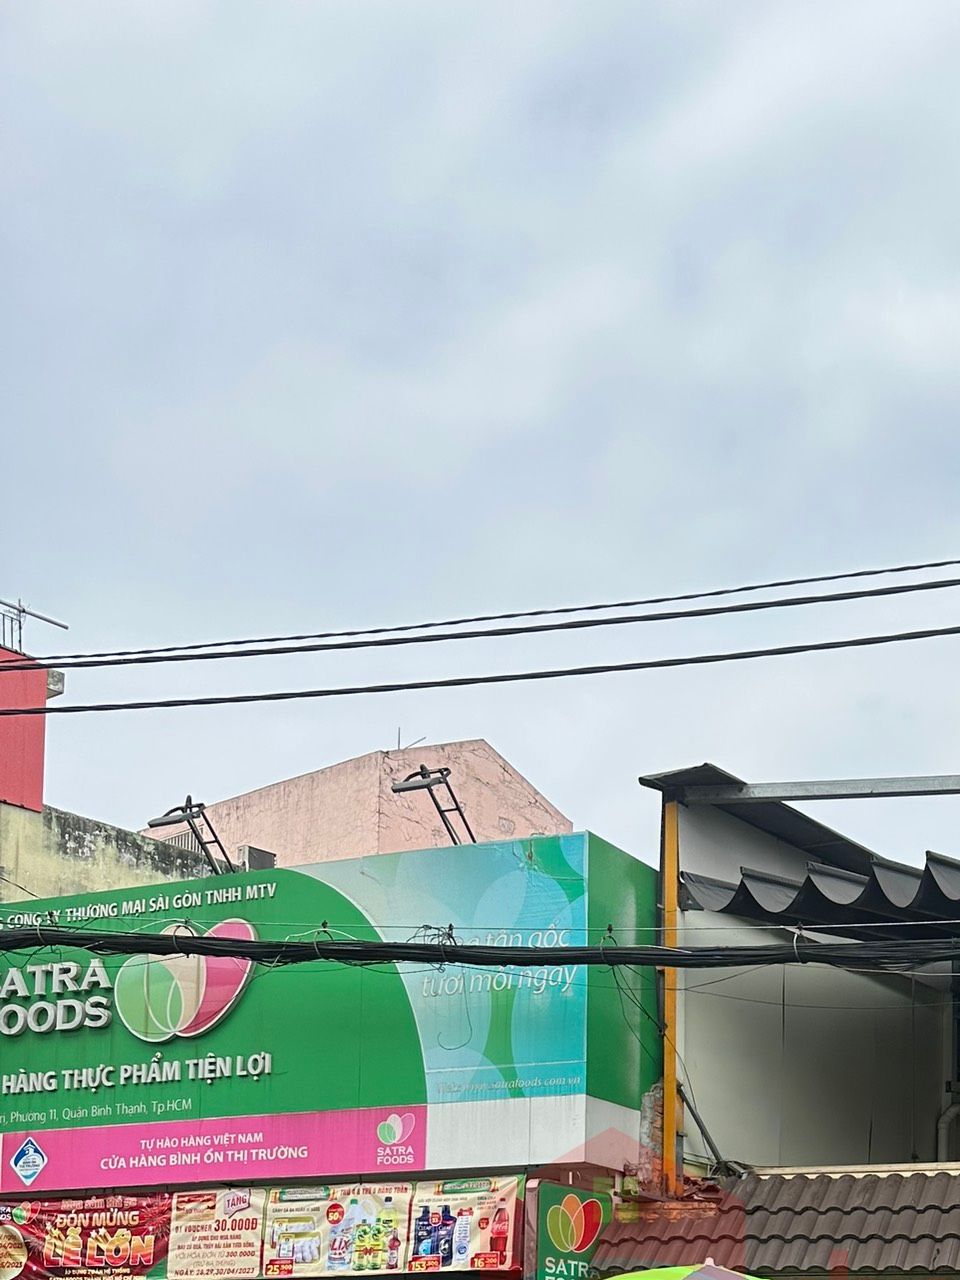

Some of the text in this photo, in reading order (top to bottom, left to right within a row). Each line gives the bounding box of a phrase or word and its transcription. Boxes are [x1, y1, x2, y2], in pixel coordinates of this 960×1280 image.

[65, 902, 118, 922] THƯƠNG
[121, 898, 146, 917] MẠI
[149, 893, 169, 912] SÀI
[172, 889, 202, 908] GÒN
[205, 886, 242, 905] TNHH
[245, 882, 277, 900] MTV
[0, 958, 113, 998] ATRA
[2, 1051, 272, 1094] HÀNG THỰC PHẨM TIỆN LỢI
[151, 1098, 192, 1115] Tp.HCM
[140, 1132, 263, 1151] TỰ HÀO HÀNG VIỆT NAM
[377, 1145, 415, 1155] SATRA
[100, 1154, 126, 1170] CỬA
[129, 1153, 167, 1168] HÀNG
[169, 1151, 200, 1166] BÌNH
[226, 1149, 248, 1164] THỊ
[250, 1145, 308, 1160] TRƯỜNG
[377, 1155, 415, 1165] FOODS
[56, 1207, 140, 1228] ĐÓN MỪNG
[184, 1224, 212, 1233] VOUCHER
